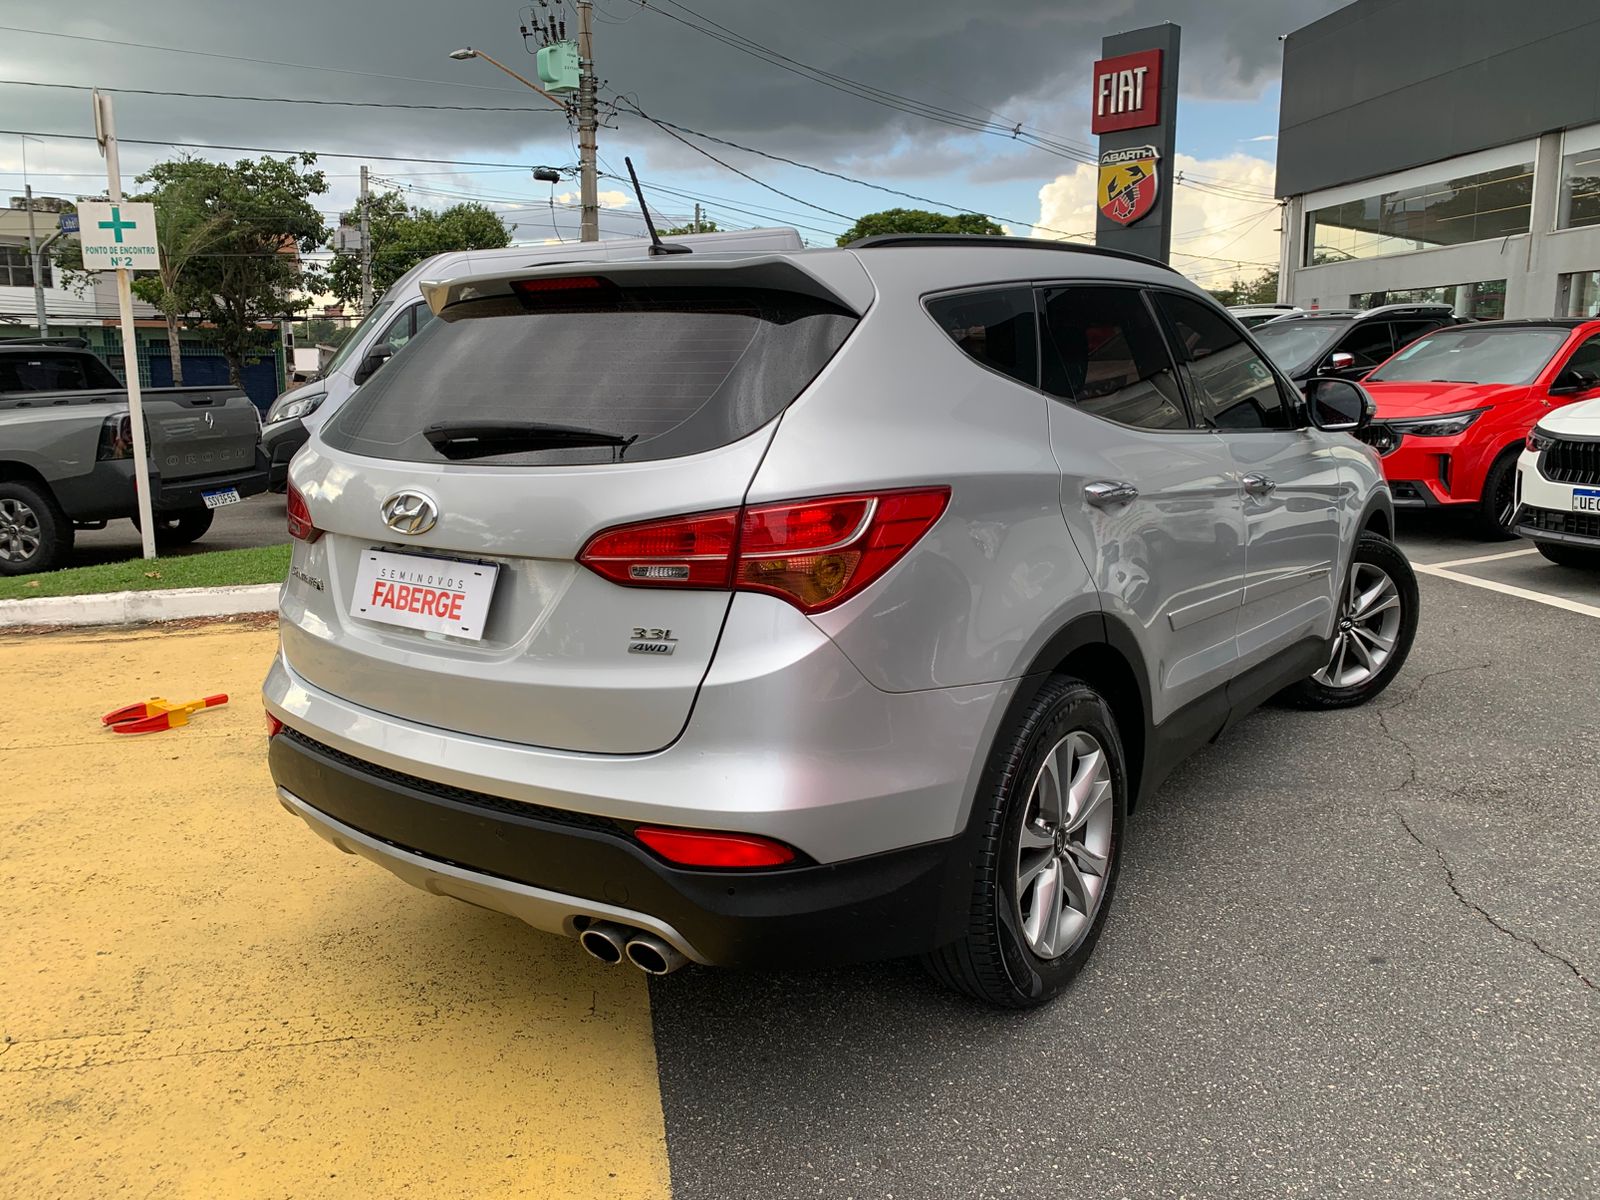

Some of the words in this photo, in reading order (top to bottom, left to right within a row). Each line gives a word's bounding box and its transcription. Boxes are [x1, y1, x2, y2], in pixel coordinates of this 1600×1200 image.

[1097, 66, 1148, 116] FIAT
[1102, 150, 1153, 164] ABARTH
[85, 246, 108, 255] PONTO
[109, 246, 119, 255] DE
[119, 246, 156, 255] ENCONTRO
[124, 256, 133, 266] 2
[166, 447, 247, 466] OROCH
[381, 568, 464, 589] SEMINOVOS
[371, 581, 465, 621] FABERGE
[632, 643, 669, 653] 4WD
